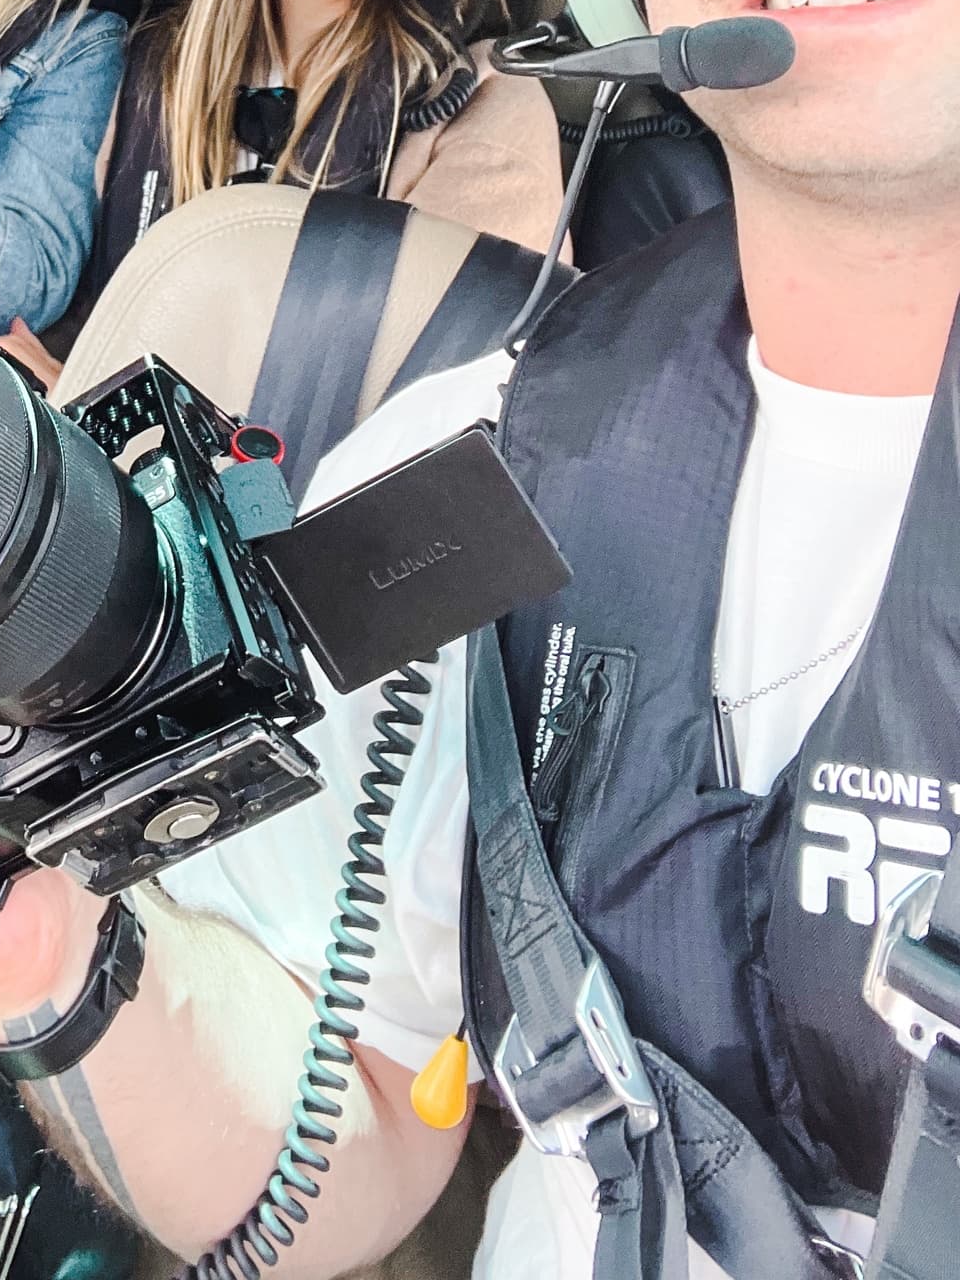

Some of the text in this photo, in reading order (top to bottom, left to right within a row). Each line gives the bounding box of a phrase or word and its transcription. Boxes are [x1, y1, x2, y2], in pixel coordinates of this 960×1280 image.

[369, 535, 462, 590] LUMIX
[544, 622, 563, 686] cylinder.
[562, 626, 577, 654] tube.
[559, 654, 571, 677] oral
[553, 676, 566, 696] the
[540, 687, 552, 715] gas
[536, 717, 547, 744] the
[532, 746, 542, 769] via
[813, 763, 941, 811] CYCLONE
